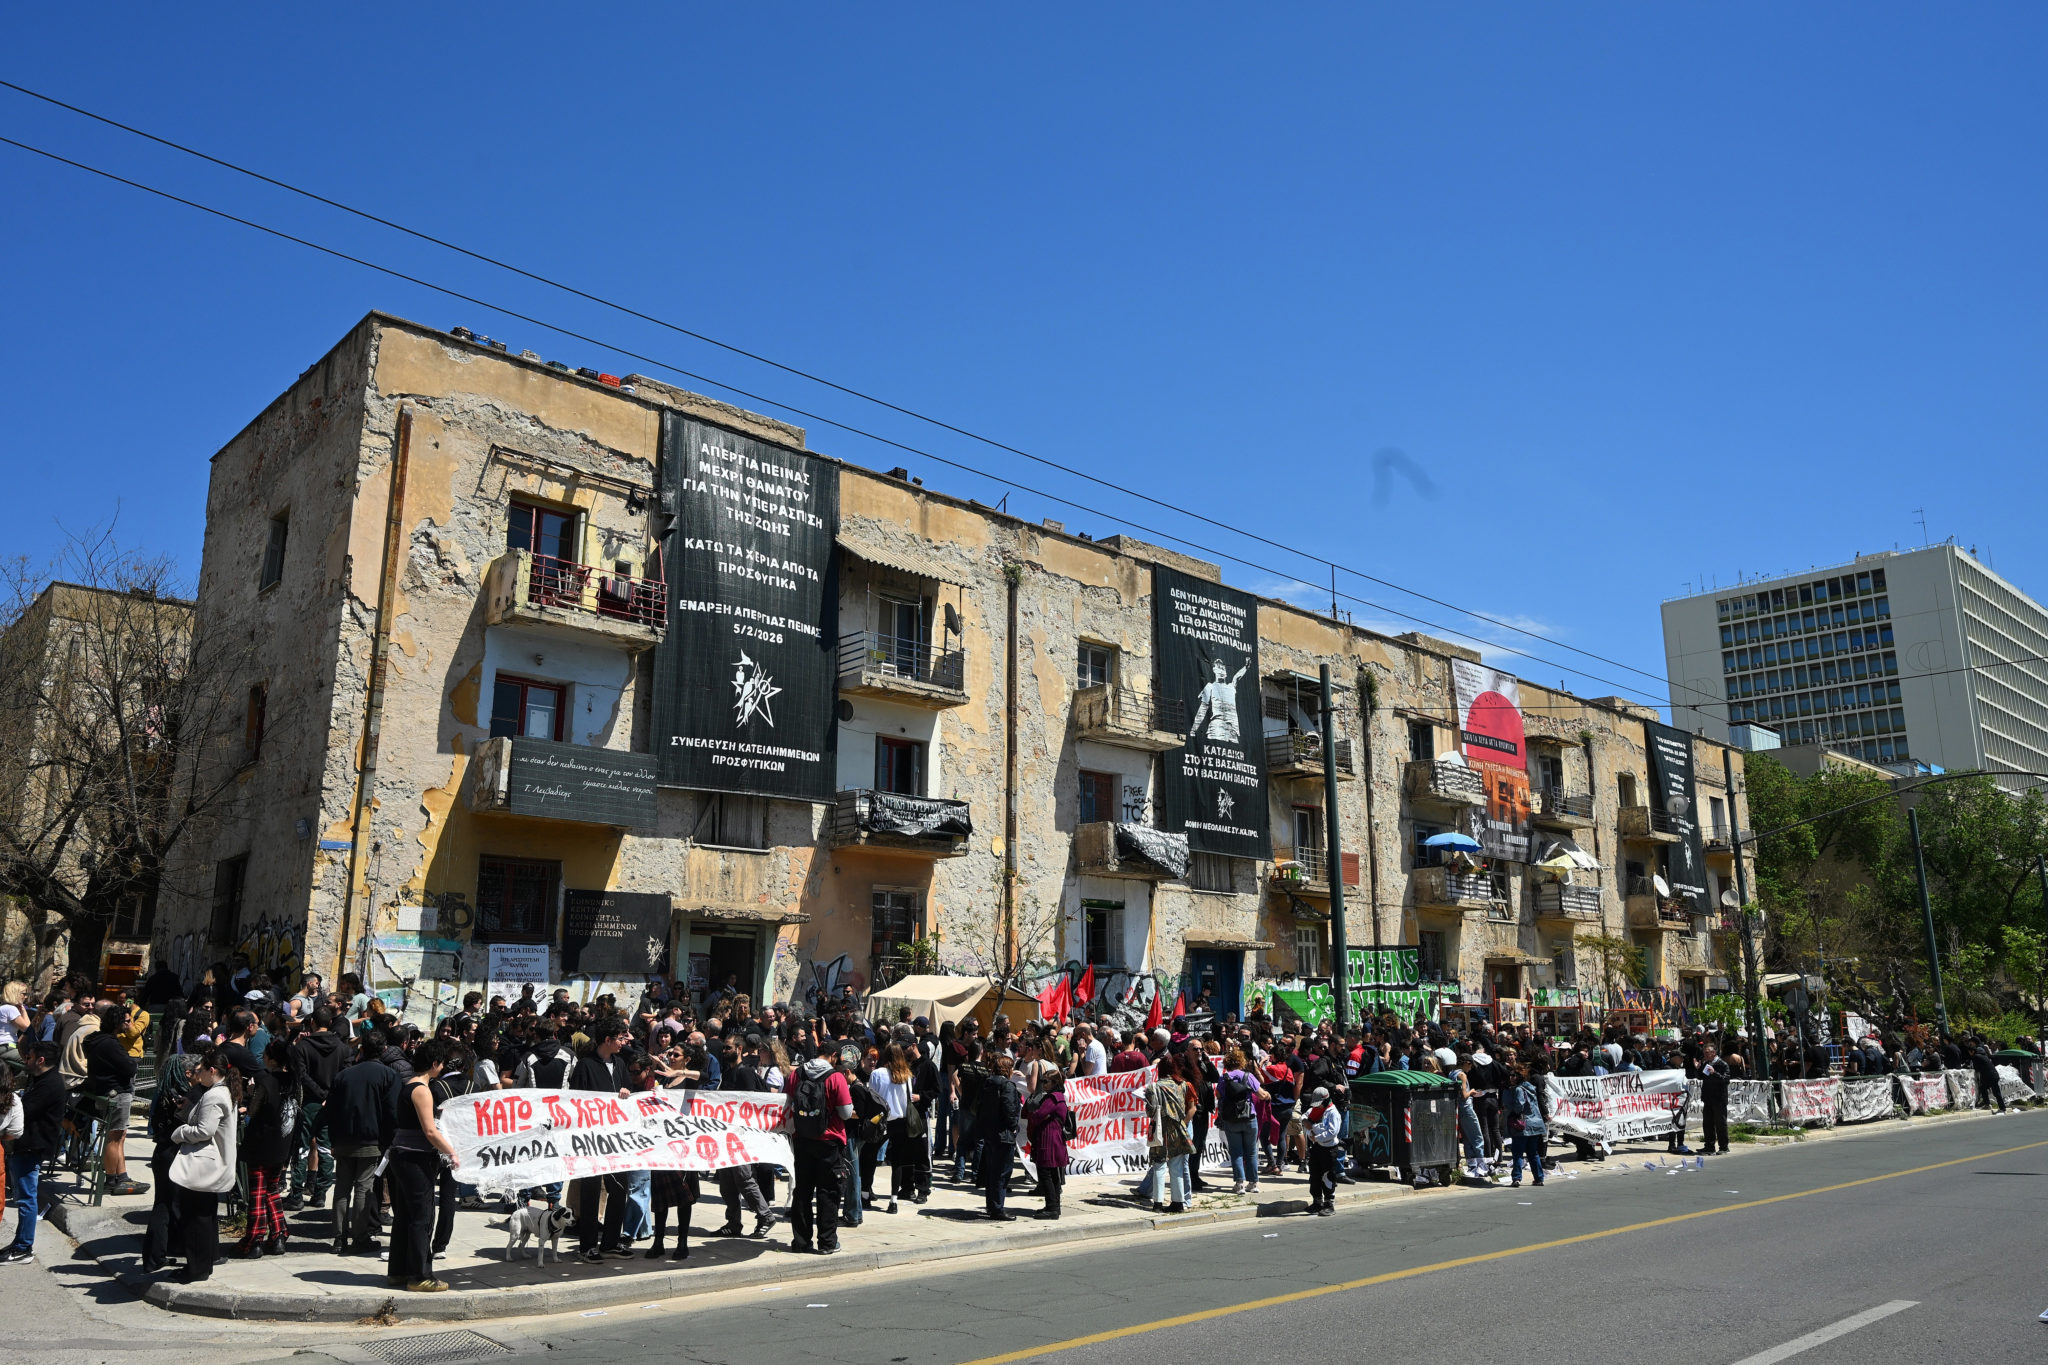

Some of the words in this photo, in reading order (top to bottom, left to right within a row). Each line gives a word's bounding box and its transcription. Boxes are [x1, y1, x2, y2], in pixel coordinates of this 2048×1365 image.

[701, 443, 760, 471] ΑΠΕΡΓΙΑ
[761, 463, 810, 486] ΠΕΙΝΑΣ
[699, 461, 743, 484] ΜΕΧΡΙ
[746, 476, 809, 503] ΘΑΝΑΤΟΥ
[683, 478, 708, 493] ΓΙΑ
[710, 483, 740, 502] ΤΗΝ
[742, 493, 823, 530] ΥΠΕΡΑΣΠΙΣΗ
[725, 506, 753, 525] ΤΗΣ
[755, 516, 791, 536] ΖΩΗΣ
[685, 538, 723, 553] ΚΑΤΩ
[726, 543, 743, 557] ΤΑ
[745, 548, 780, 569] ΧΕΡΙΑ
[782, 560, 805, 575] ΑΠΟ
[806, 568, 819, 583] ΤΑ
[718, 561, 797, 592] ΠΡΟΣΦΥΓΙΚΑ
[1170, 587, 1187, 600] ΔΕΝ
[1185, 593, 1220, 610] ΥΠΑΡΧΕΙ
[1221, 602, 1247, 618] ΕΙΡΗΝΗ
[1174, 600, 1198, 615] ΧΩΡΙΣ
[1199, 607, 1244, 629] ΔΙΚΑΙΟΣΥΝΗ
[679, 599, 732, 615] ΕΝΑΡΞΗ
[733, 606, 786, 628] ΑΠΕΡΓΙΑΣ
[787, 619, 822, 639] ΠΕΙΝΑΣ
[1194, 618, 1207, 629] ΘΑ
[733, 623, 784, 644] 5/2/2026
[547, 755, 559, 767] δεν
[671, 736, 736, 751] ΣΥΝΕΛΕΥΣΗ
[738, 743, 820, 762] ΚΑΤΕΙΛΗΜΜΕΝΩΝ
[1203, 744, 1245, 761] ΚΑΤΑΔΙΚΗ
[712, 754, 785, 772] ΠΡΟΣΦΥΓΙΚΩΝ
[1182, 766, 1200, 777] ΤΟΥ
[1201, 769, 1233, 782] ΒΑΣΙΛΗ
[1184, 753, 1214, 766] ΣΤΟΥΣ
[1215, 758, 1257, 775] ΒΑΣΑΝΙΣΤΕΣ
[542, 1095, 571, 1129] ΤΑ
[570, 1097, 629, 1129] ΧΕΡΙΑ
[571, 1131, 655, 1156] ΑΝΟΙΧΤΑ
[1104, 1118, 1126, 1142] ΚΑΙ
